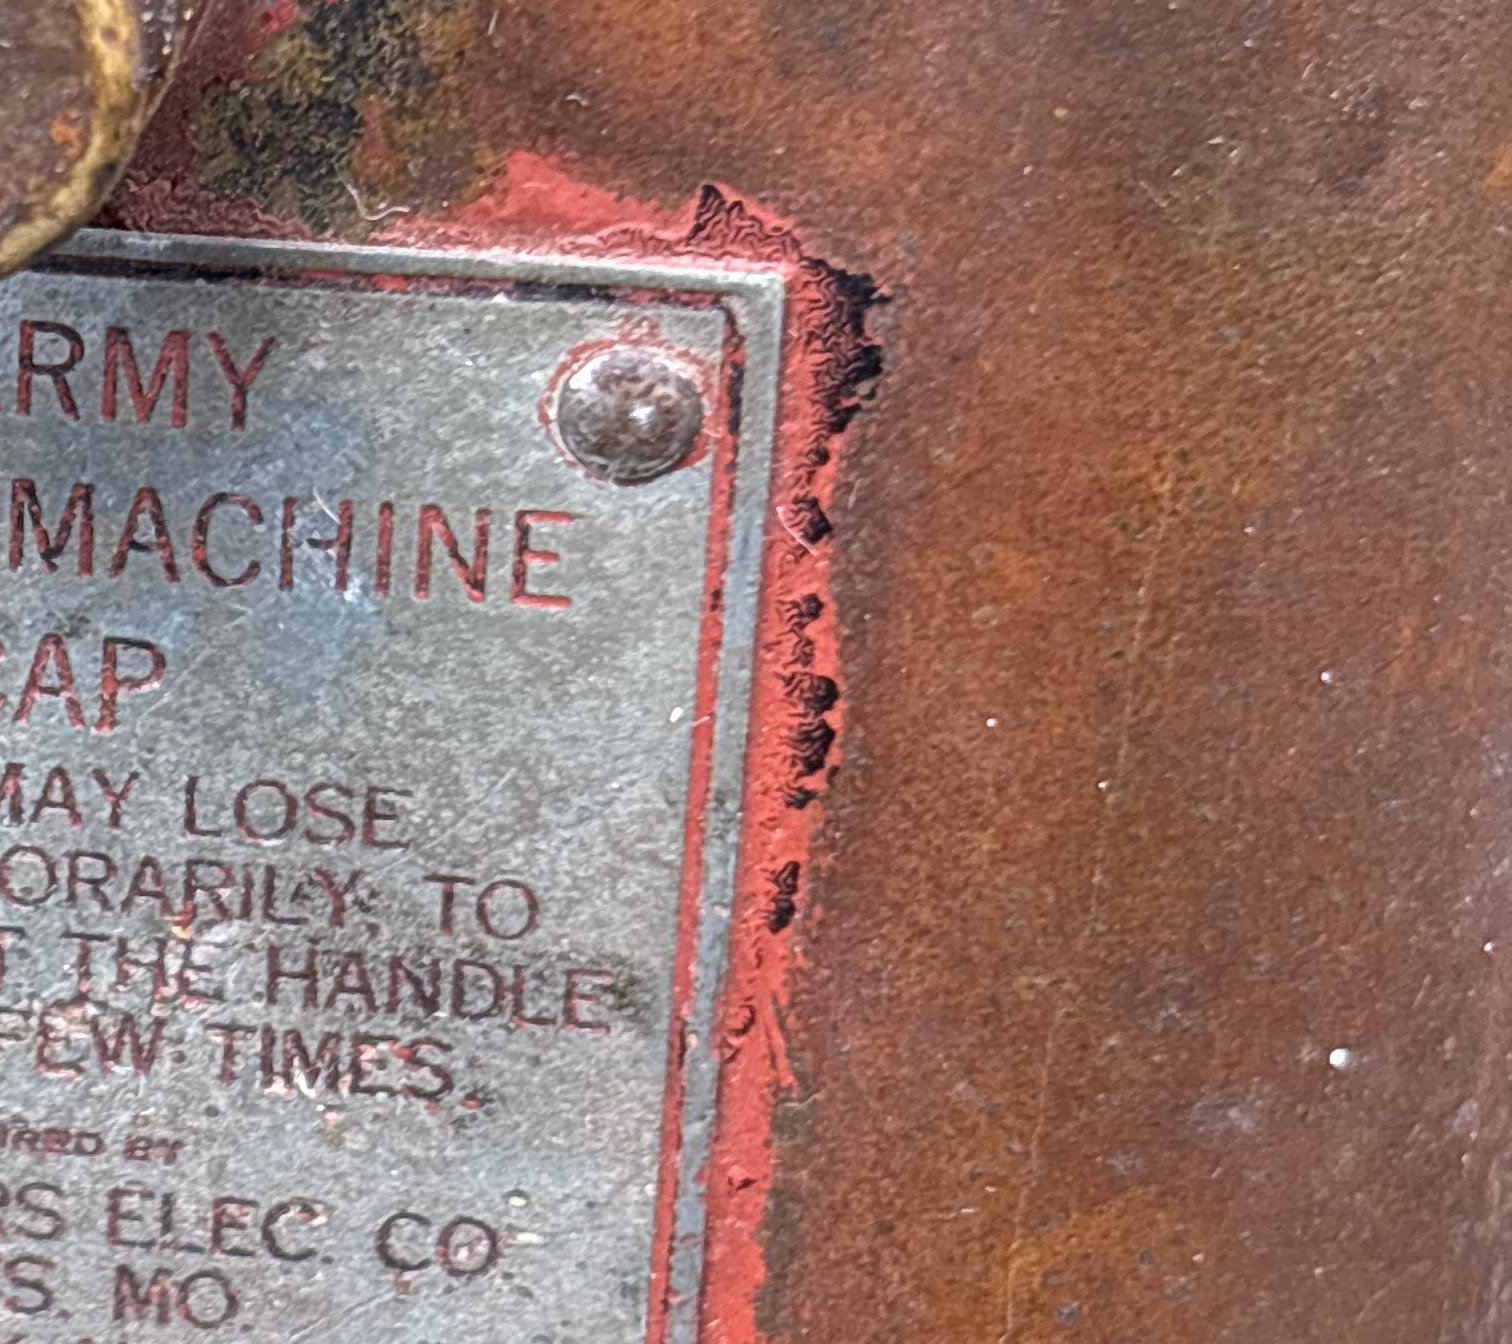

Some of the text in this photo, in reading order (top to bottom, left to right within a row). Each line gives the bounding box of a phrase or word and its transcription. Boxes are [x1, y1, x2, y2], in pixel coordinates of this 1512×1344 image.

[8, 478, 579, 609] MACHINE
[185, 776, 413, 850] LOSE
[423, 873, 540, 941] TO
[61, 931, 223, 1010] THE
[267, 947, 615, 1032] HANDLE
[123, 1131, 184, 1165] BY
